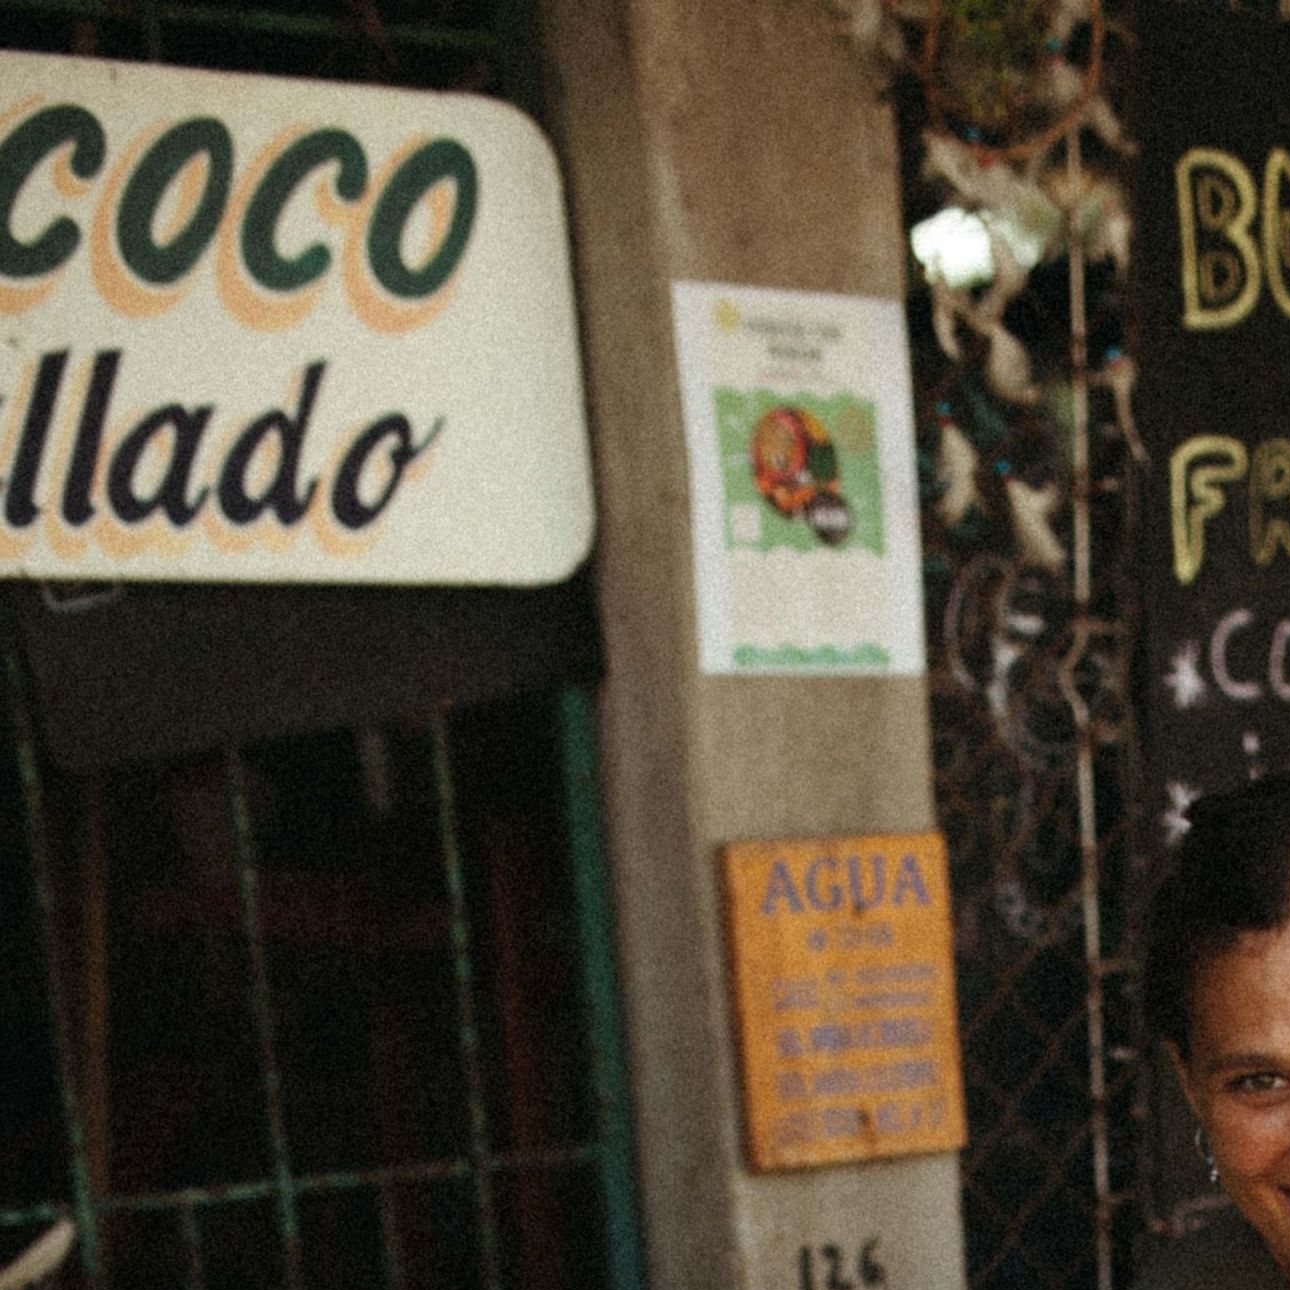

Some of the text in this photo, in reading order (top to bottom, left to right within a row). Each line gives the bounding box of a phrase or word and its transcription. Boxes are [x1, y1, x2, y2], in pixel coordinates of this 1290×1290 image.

[0, 102, 479, 302] COCO
[0, 345, 446, 531] llado
[758, 852, 933, 917] AGUA
